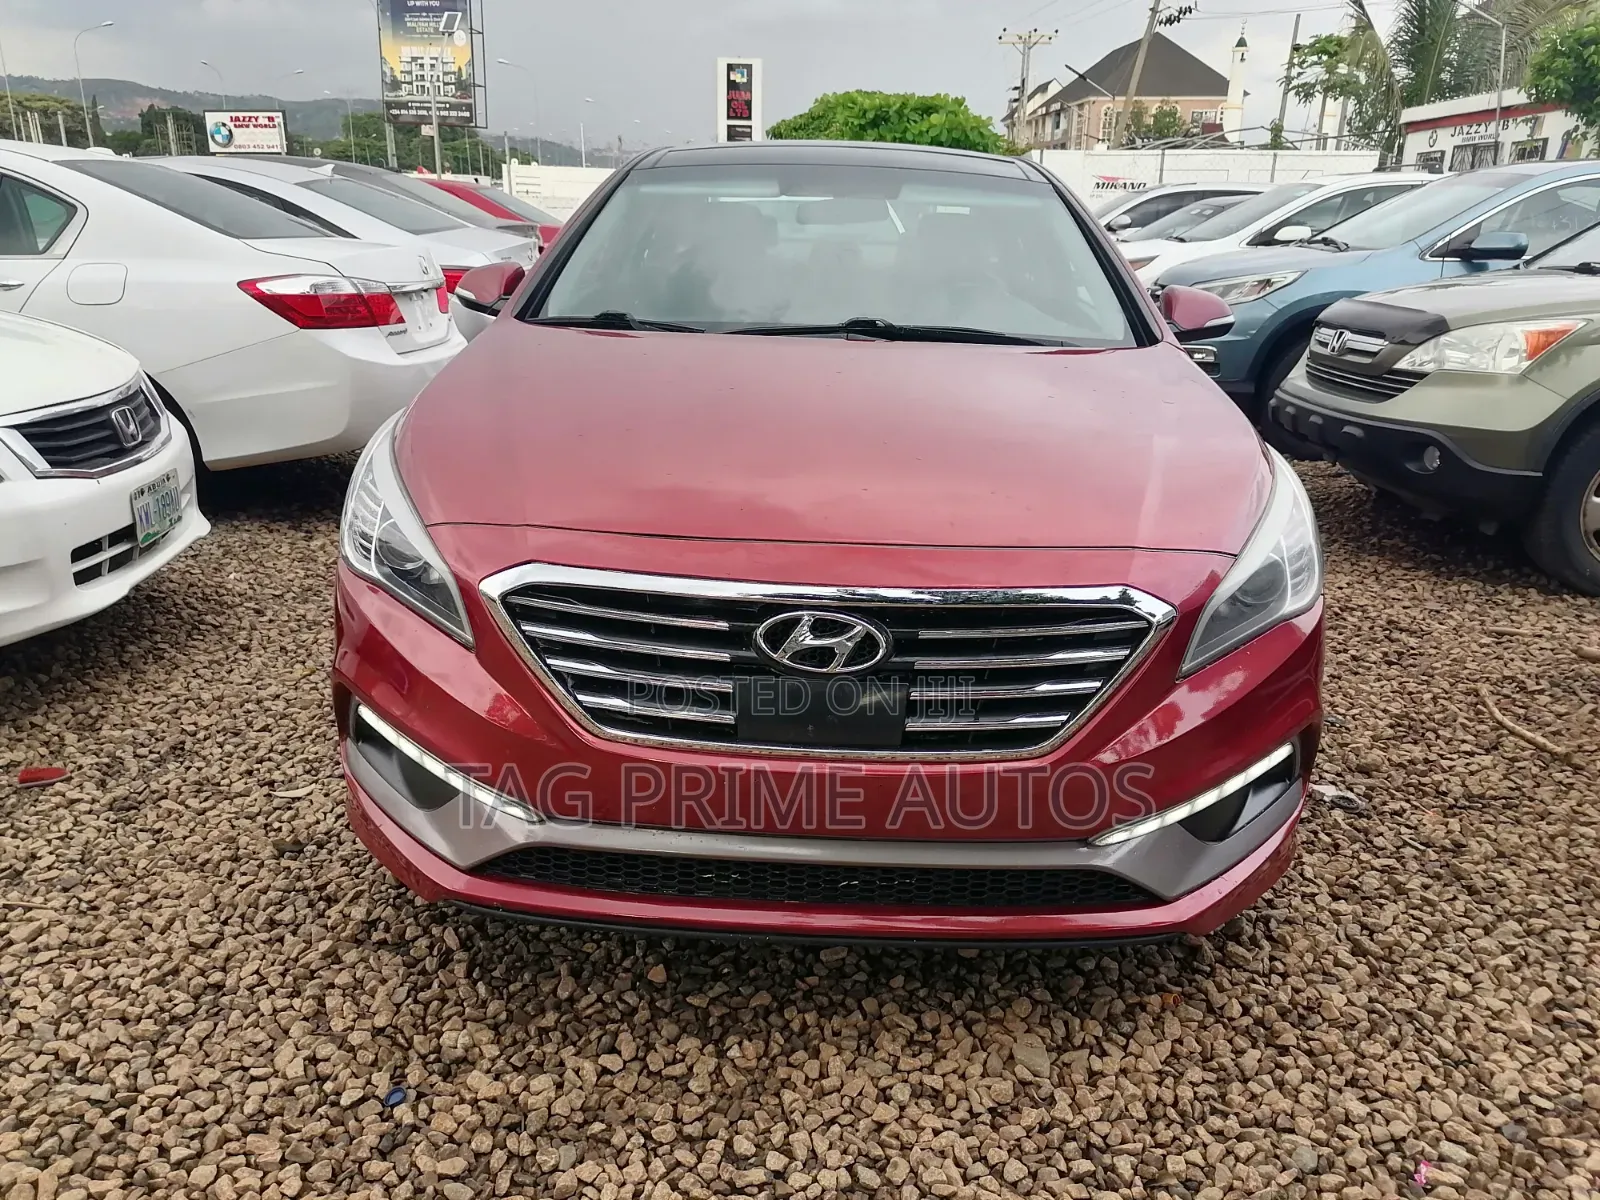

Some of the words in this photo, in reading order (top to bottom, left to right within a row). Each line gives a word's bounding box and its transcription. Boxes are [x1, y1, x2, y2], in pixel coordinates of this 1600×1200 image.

[729, 108, 749, 117] LTD
[1451, 122, 1491, 137] JAZZY
[1478, 133, 1500, 141] WORL
